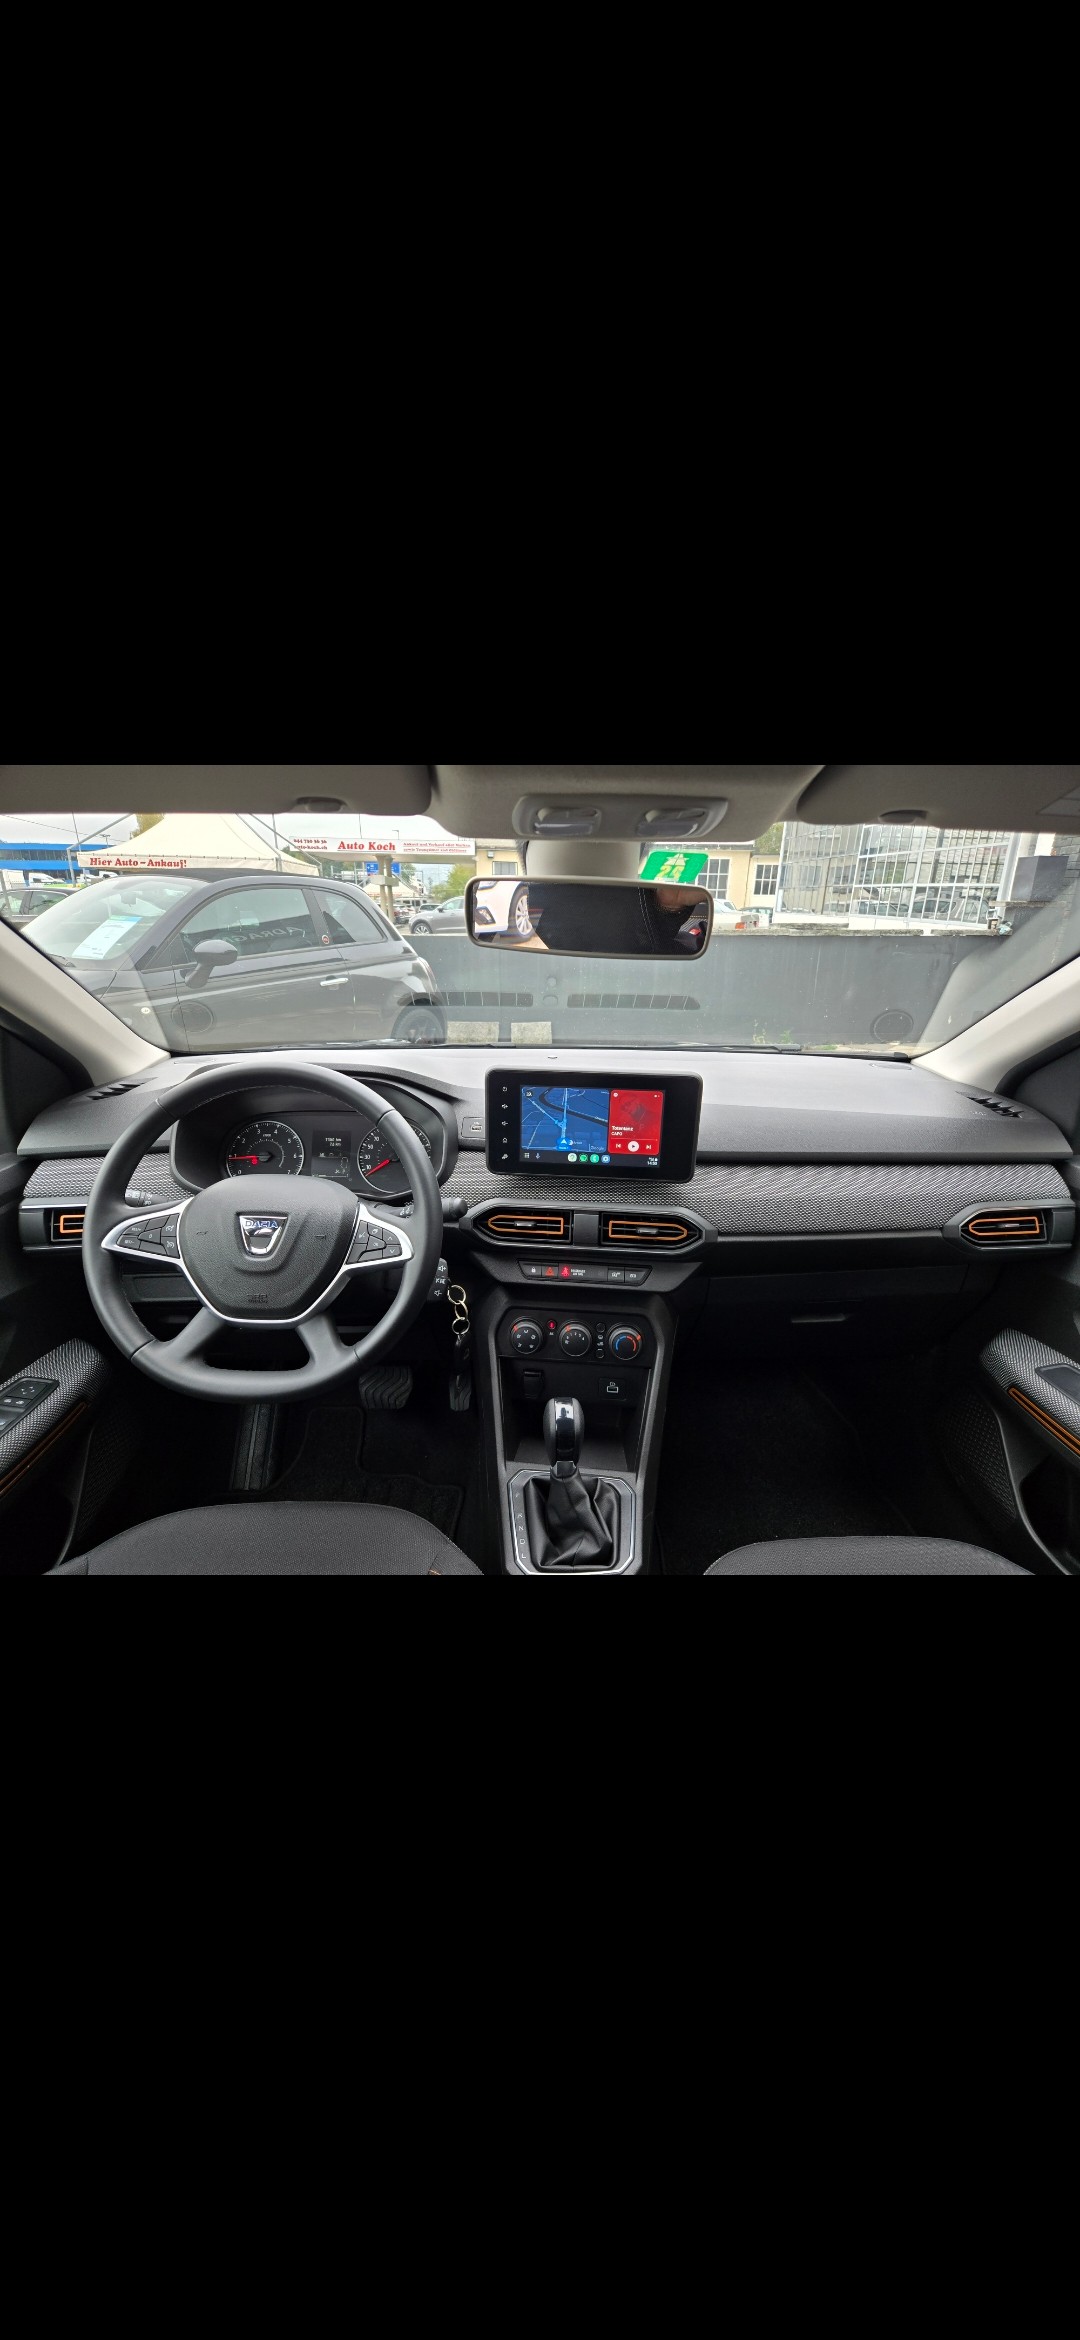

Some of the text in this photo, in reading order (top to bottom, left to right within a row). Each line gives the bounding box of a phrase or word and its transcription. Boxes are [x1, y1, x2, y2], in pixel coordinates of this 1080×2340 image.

[338, 841, 396, 851] Auto Koch
[90, 858, 112, 866] Hier
